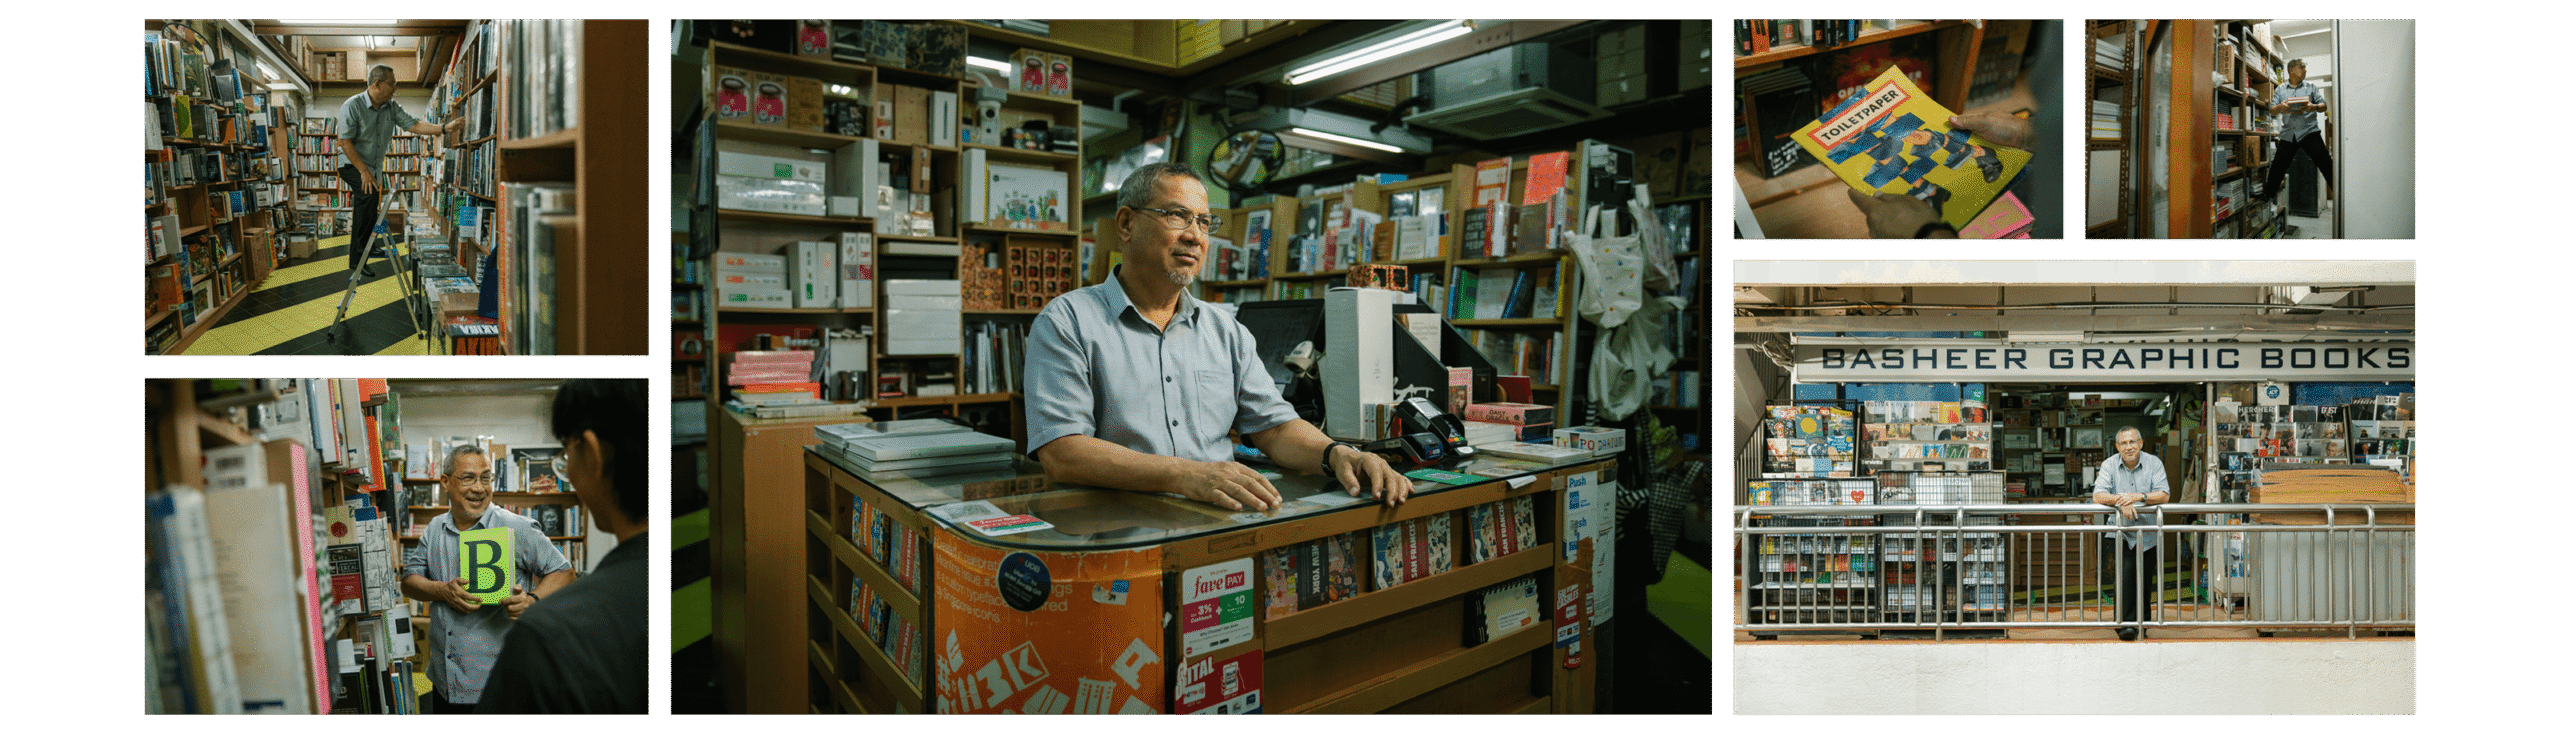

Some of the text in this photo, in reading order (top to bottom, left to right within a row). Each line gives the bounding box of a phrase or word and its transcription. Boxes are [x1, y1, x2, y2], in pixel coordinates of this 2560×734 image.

[1820, 89, 1899, 140] TOILETPAPER
[1822, 347, 2411, 370] BASHEER GRAPHIC BOOKS
[1569, 475, 1586, 488] Push
[1500, 539, 1510, 555] SAN
[464, 540, 506, 593] B
[1311, 544, 1321, 594] NEW YORK
[1409, 561, 1418, 578] SAN
[1193, 574, 1243, 599] fave PAY
